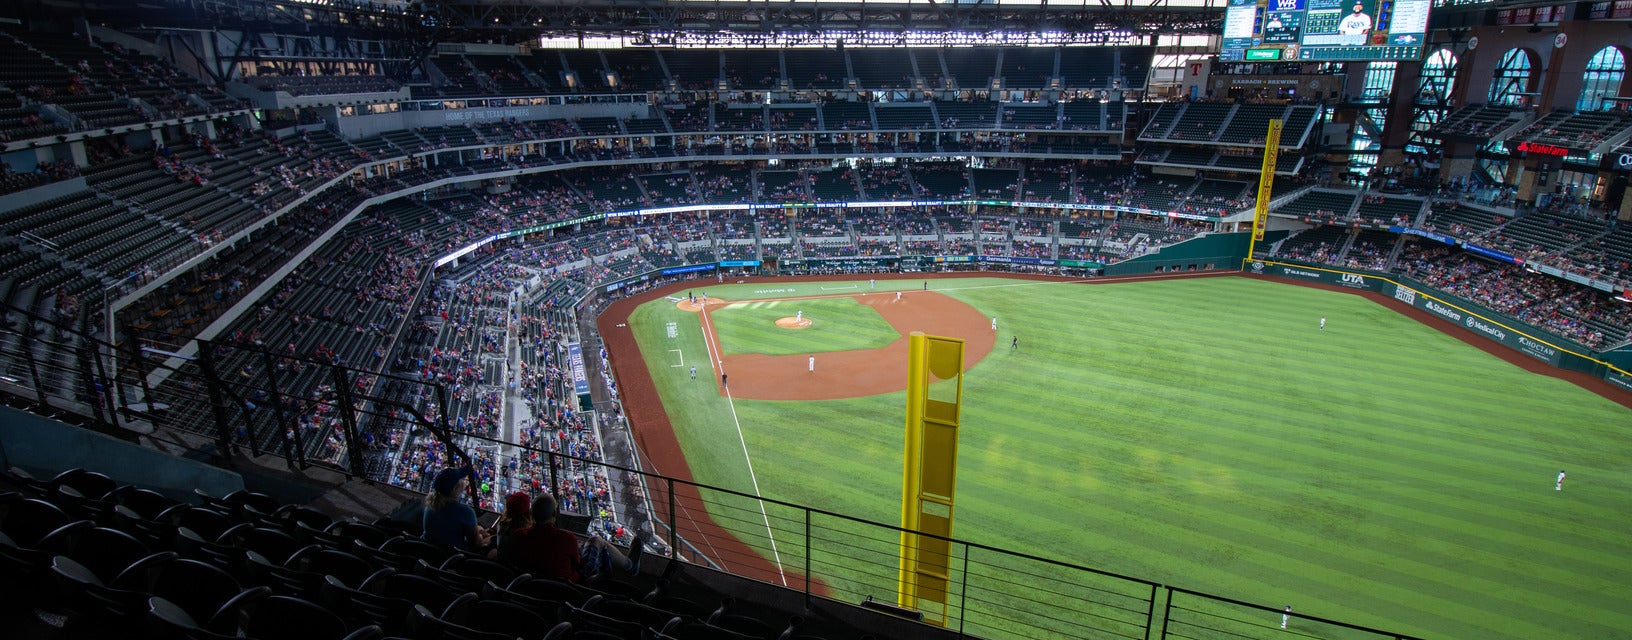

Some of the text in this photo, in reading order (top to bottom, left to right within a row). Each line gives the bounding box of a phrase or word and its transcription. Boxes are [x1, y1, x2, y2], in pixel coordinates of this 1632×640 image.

[1556, 36, 1566, 45] 34
[1190, 63, 1202, 76] T
[445, 108, 529, 120] HOME OF THE TEXAS RANGERS
[1342, 273, 1364, 285] UTA
[1395, 289, 1416, 306] SELTZER
[1520, 337, 1556, 356] CHOCTAW
